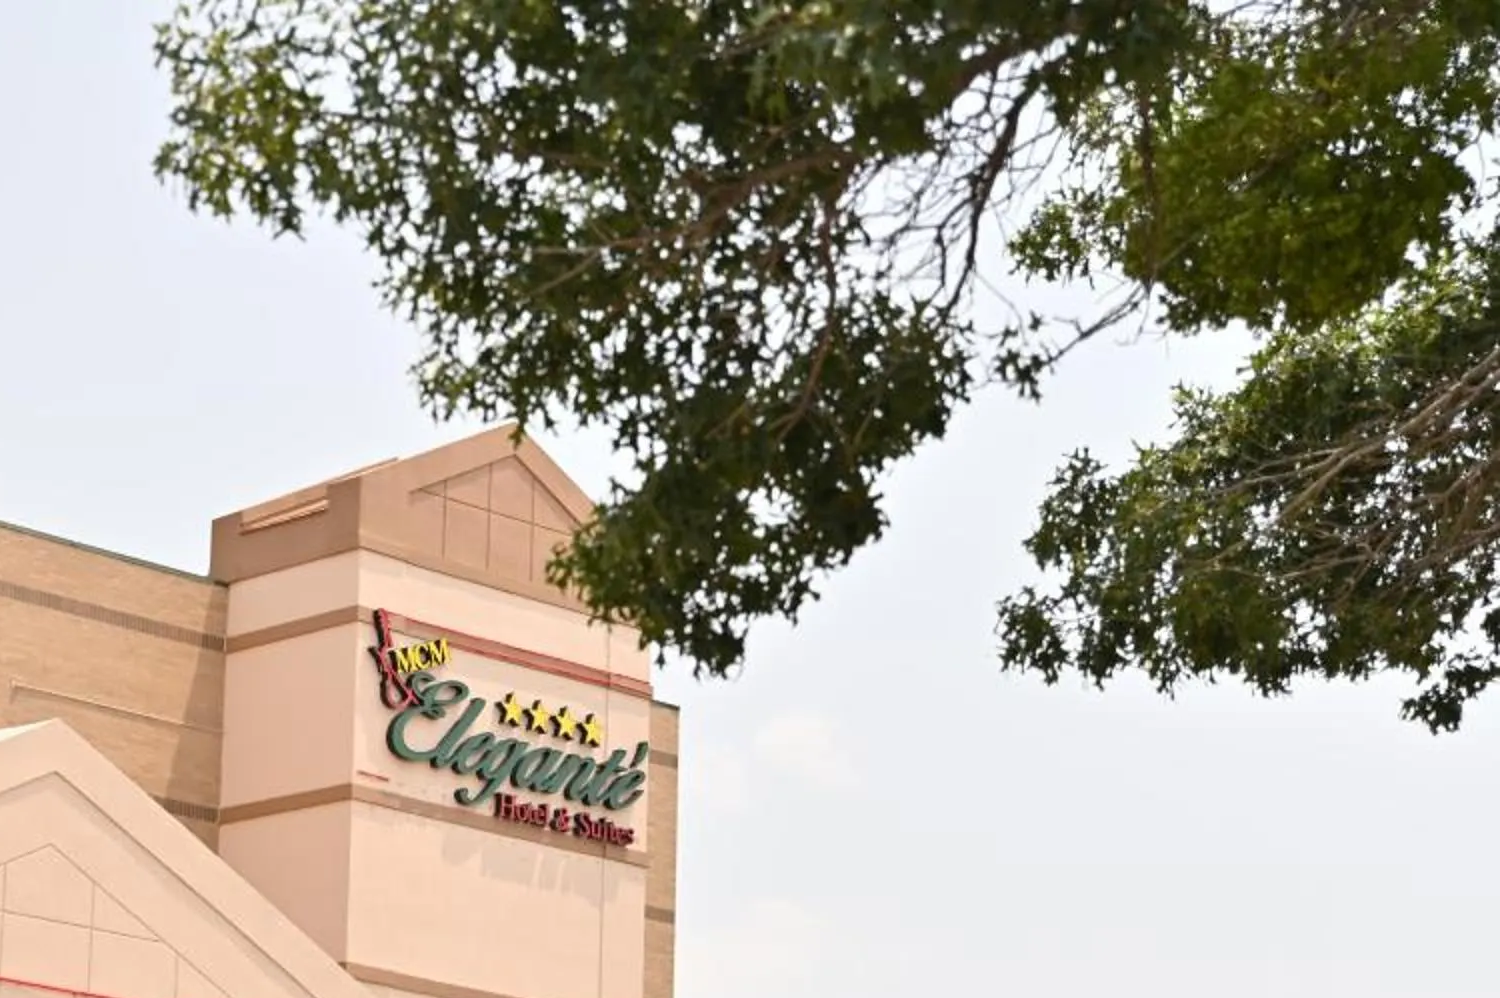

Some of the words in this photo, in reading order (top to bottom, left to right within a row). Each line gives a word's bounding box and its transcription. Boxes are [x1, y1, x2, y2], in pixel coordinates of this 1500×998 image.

[394, 638, 450, 673] MCM
[386, 671, 648, 811] Eleganté
[494, 792, 548, 828] Hotel
[550, 807, 570, 833] &
[573, 812, 634, 847] Suites
